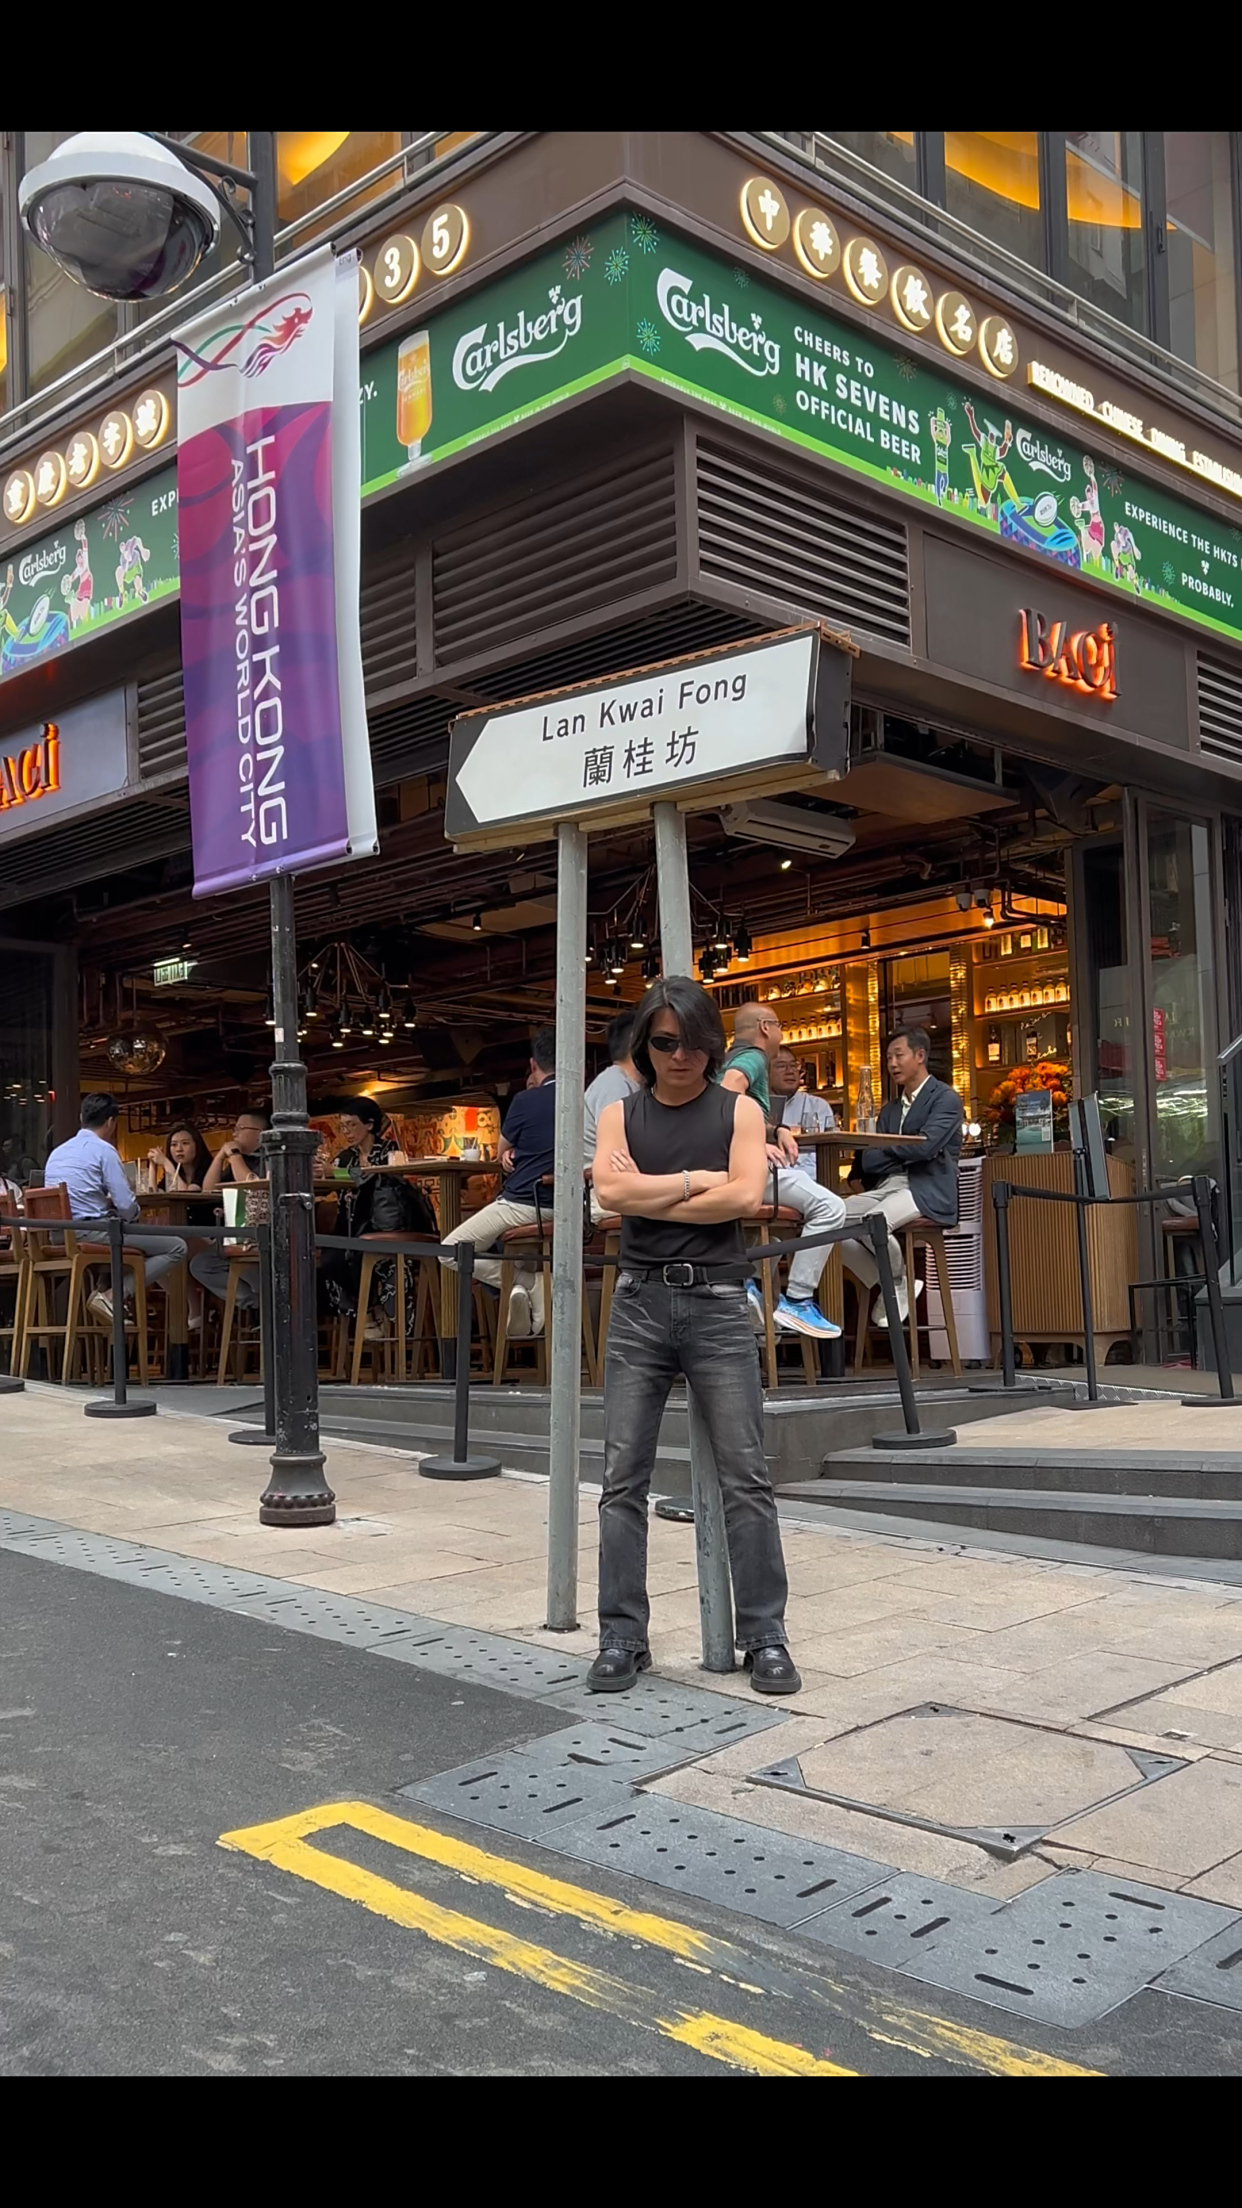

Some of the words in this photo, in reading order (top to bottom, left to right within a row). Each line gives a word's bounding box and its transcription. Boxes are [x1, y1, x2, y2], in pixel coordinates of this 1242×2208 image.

[453, 293, 583, 391] Carlsberg
[657, 267, 781, 376] Carlsberg
[794, 326, 850, 367] CHEERS
[856, 357, 874, 378] TO
[795, 352, 828, 391] HK
[835, 373, 920, 435] SEVENS
[1031, 361, 1095, 411] RENOWNED
[796, 390, 874, 443] OFFICIAL
[880, 428, 922, 465] BEER
[1016, 428, 1072, 482] Carlsberg
[151, 488, 179, 517] EXP
[231, 459, 247, 588] ASIA'S
[246, 435, 279, 636] HONG
[1124, 501, 1189, 544] EXPERIENCE
[1191, 533, 1211, 555] THE
[1213, 544, 1239, 568] HK7S
[19, 544, 67, 587] Carlsberg
[1181, 572, 1234, 608] PROBABLY.
[235, 592, 251, 744] WORLD
[542, 712, 586, 741] Lan
[600, 688, 664, 728] Kwai
[679, 673, 747, 709] Fong
[252, 644, 288, 845] KONG
[583, 725, 699, 788] 蘭桂坊
[239, 753, 257, 848] CITY
